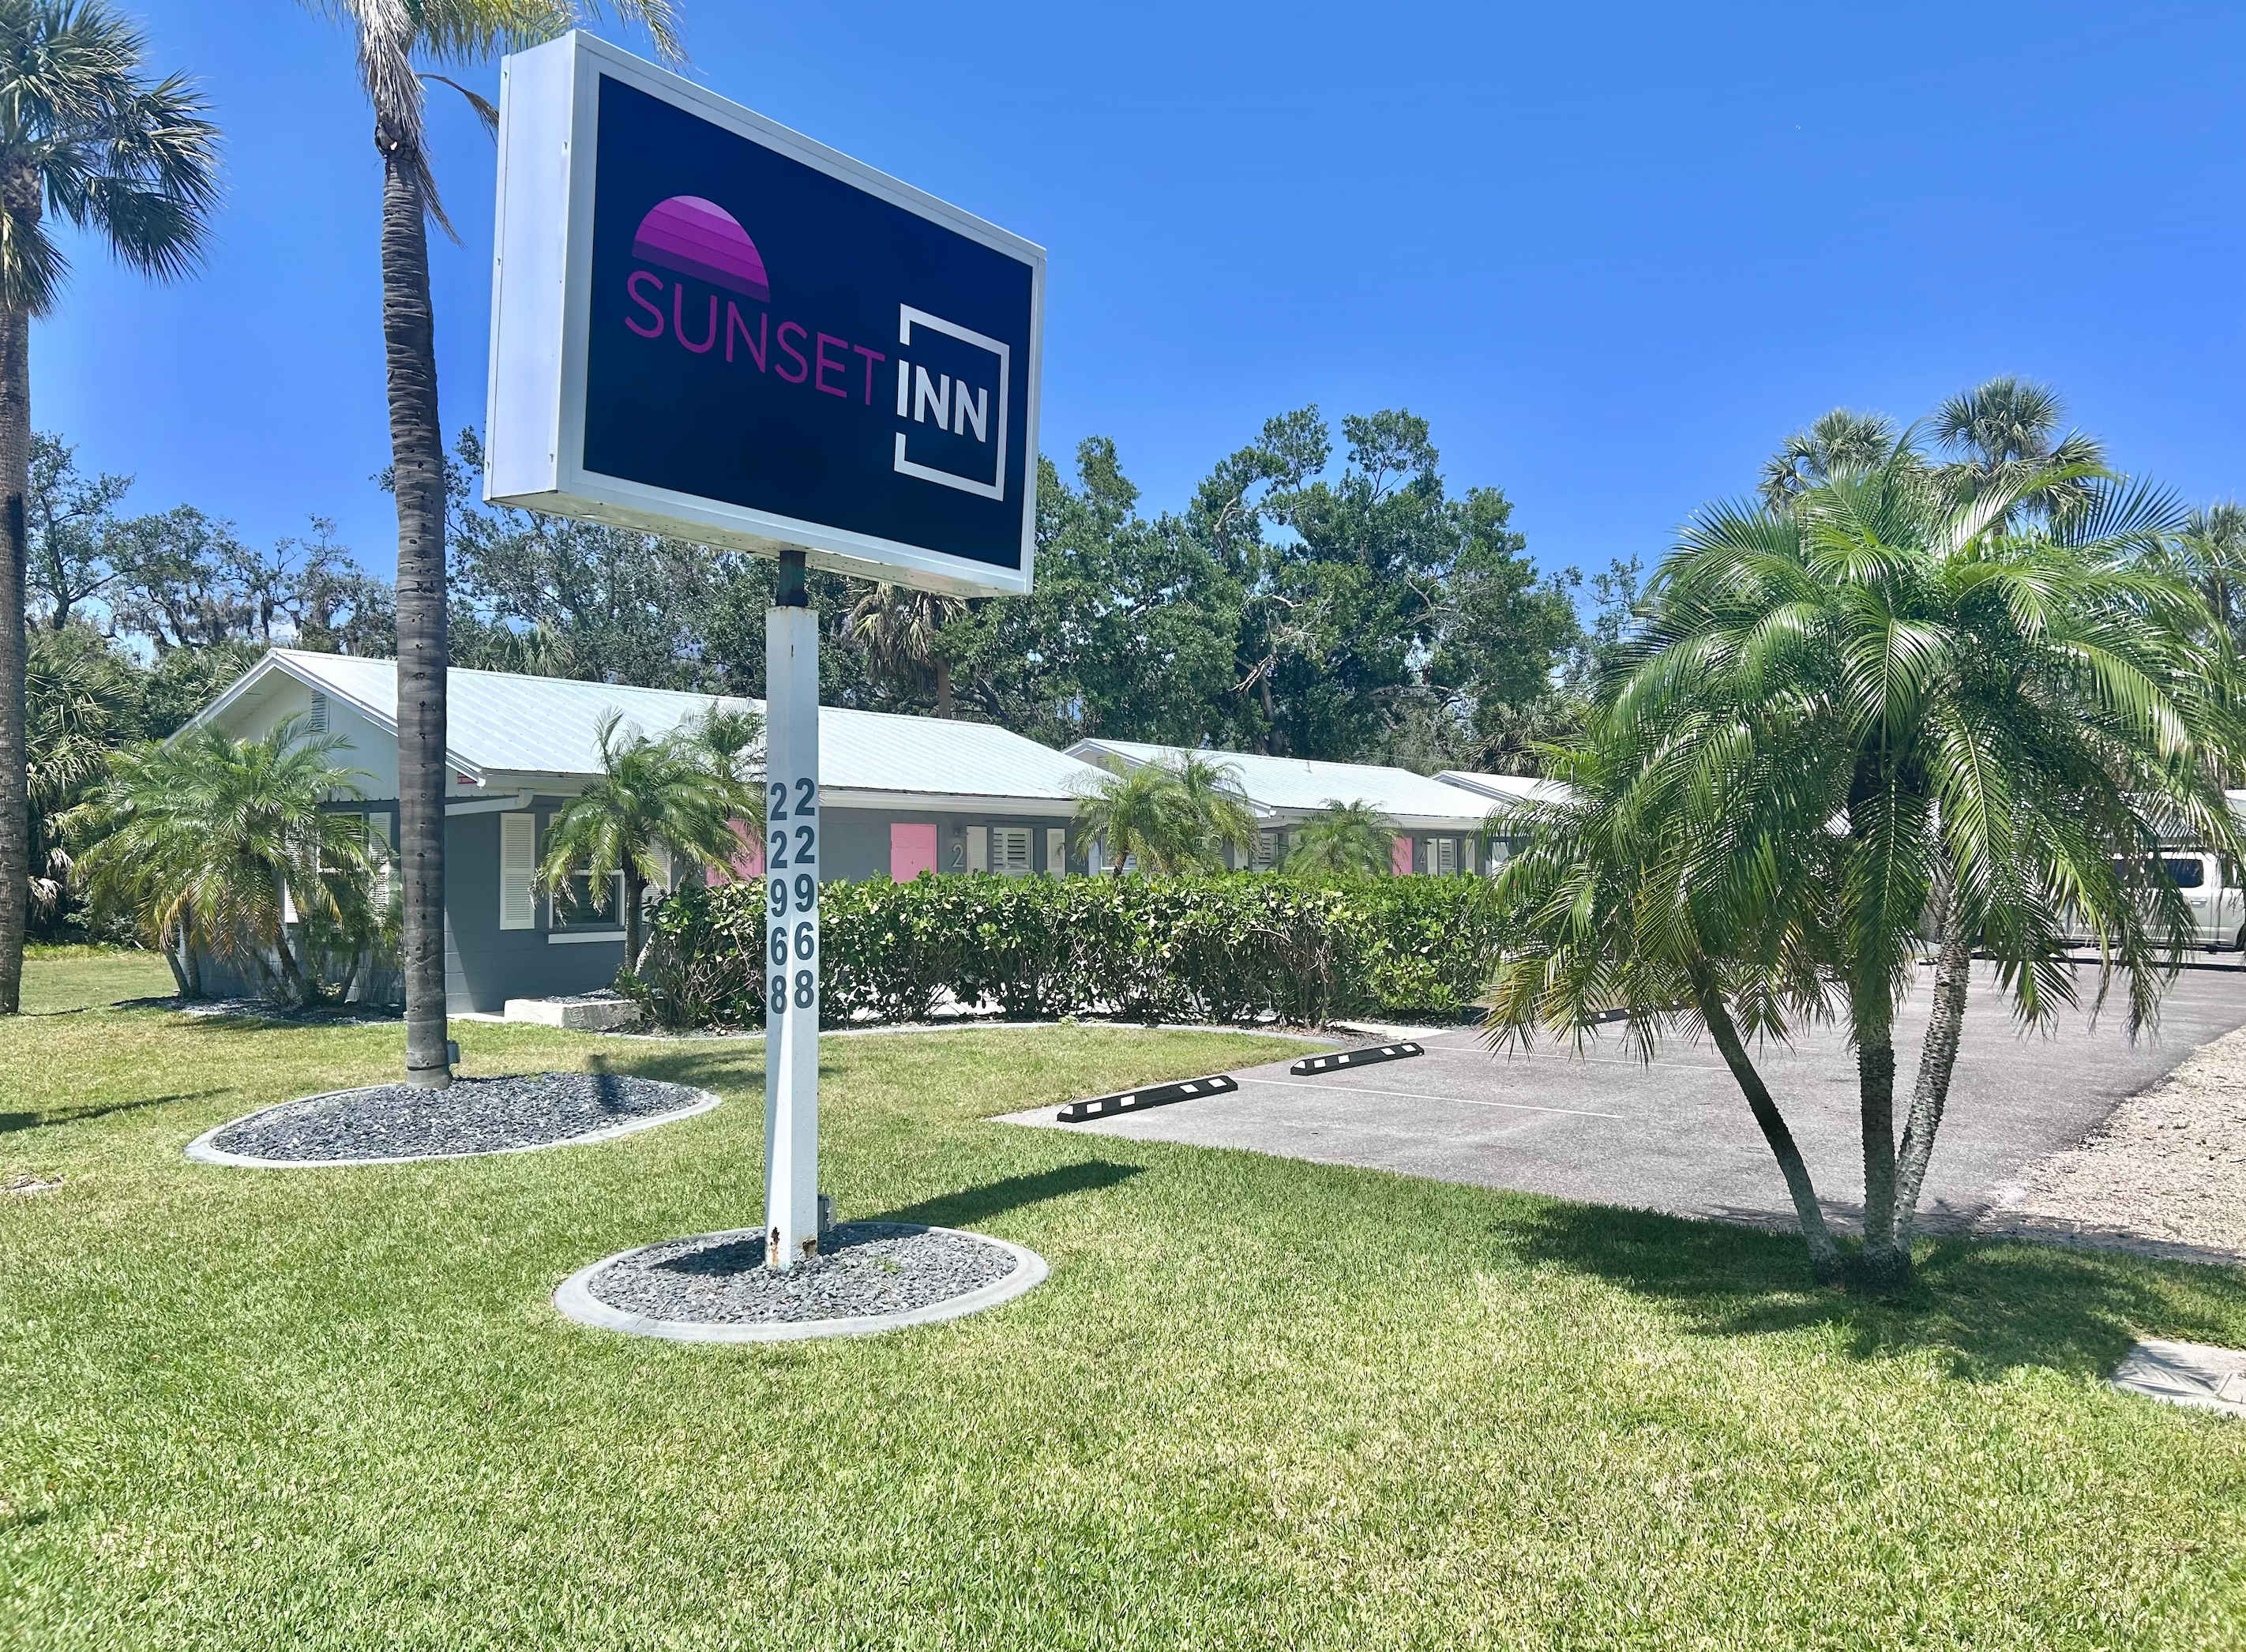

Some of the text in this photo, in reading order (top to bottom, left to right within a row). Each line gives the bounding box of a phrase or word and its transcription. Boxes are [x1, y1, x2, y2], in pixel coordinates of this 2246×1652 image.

[625, 270, 988, 443] SUNSET INN
[770, 782, 788, 1015] 22968
[794, 777, 816, 1009] 22968
[952, 844, 963, 868] 2
